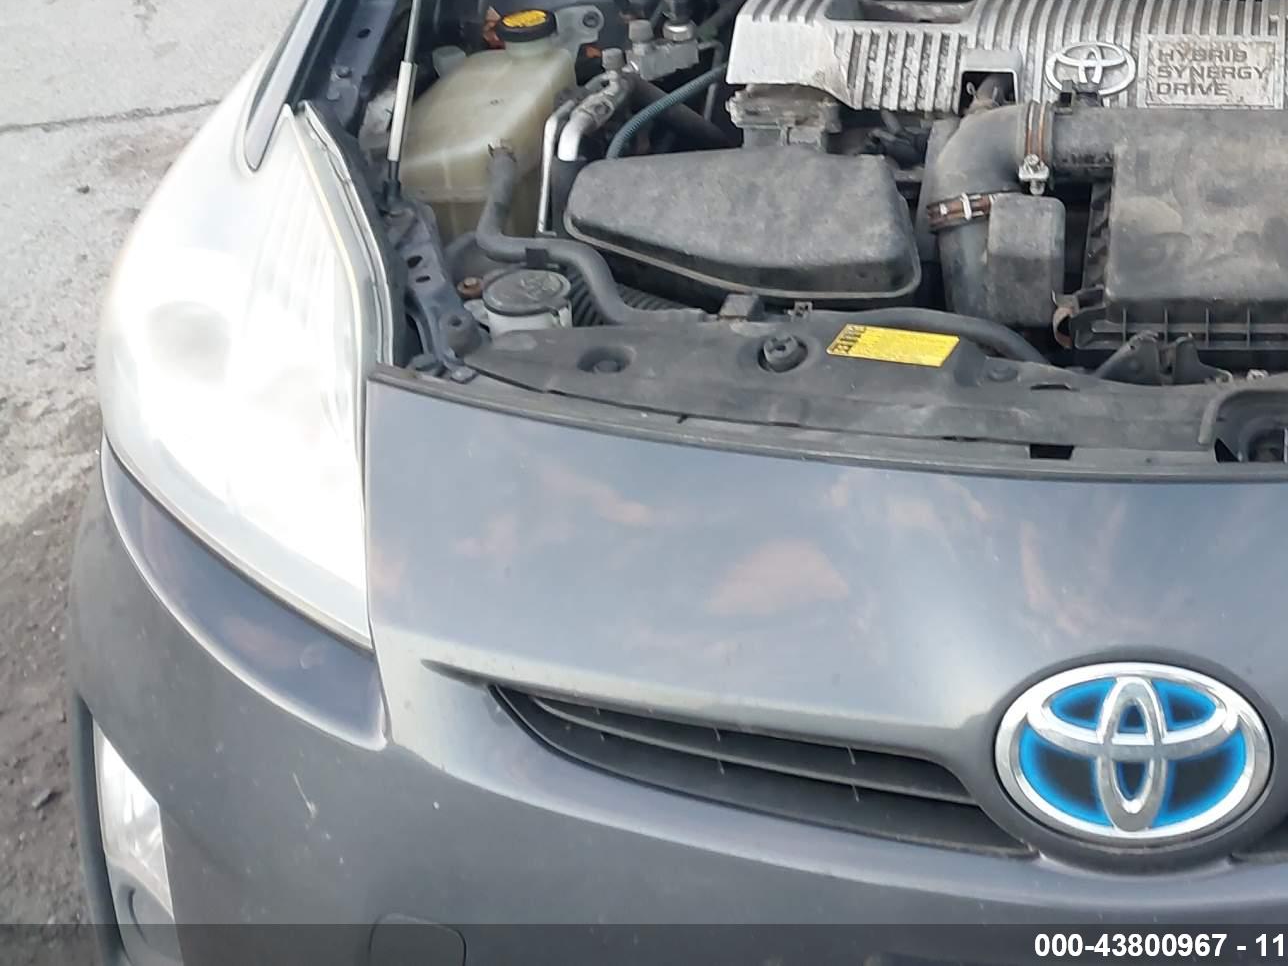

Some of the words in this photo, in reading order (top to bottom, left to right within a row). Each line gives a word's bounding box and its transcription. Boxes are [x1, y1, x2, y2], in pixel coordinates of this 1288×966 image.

[1158, 48, 1248, 63] HYBRID
[1157, 64, 1269, 80] SYNERGY
[1156, 81, 1229, 96] DRIVE
